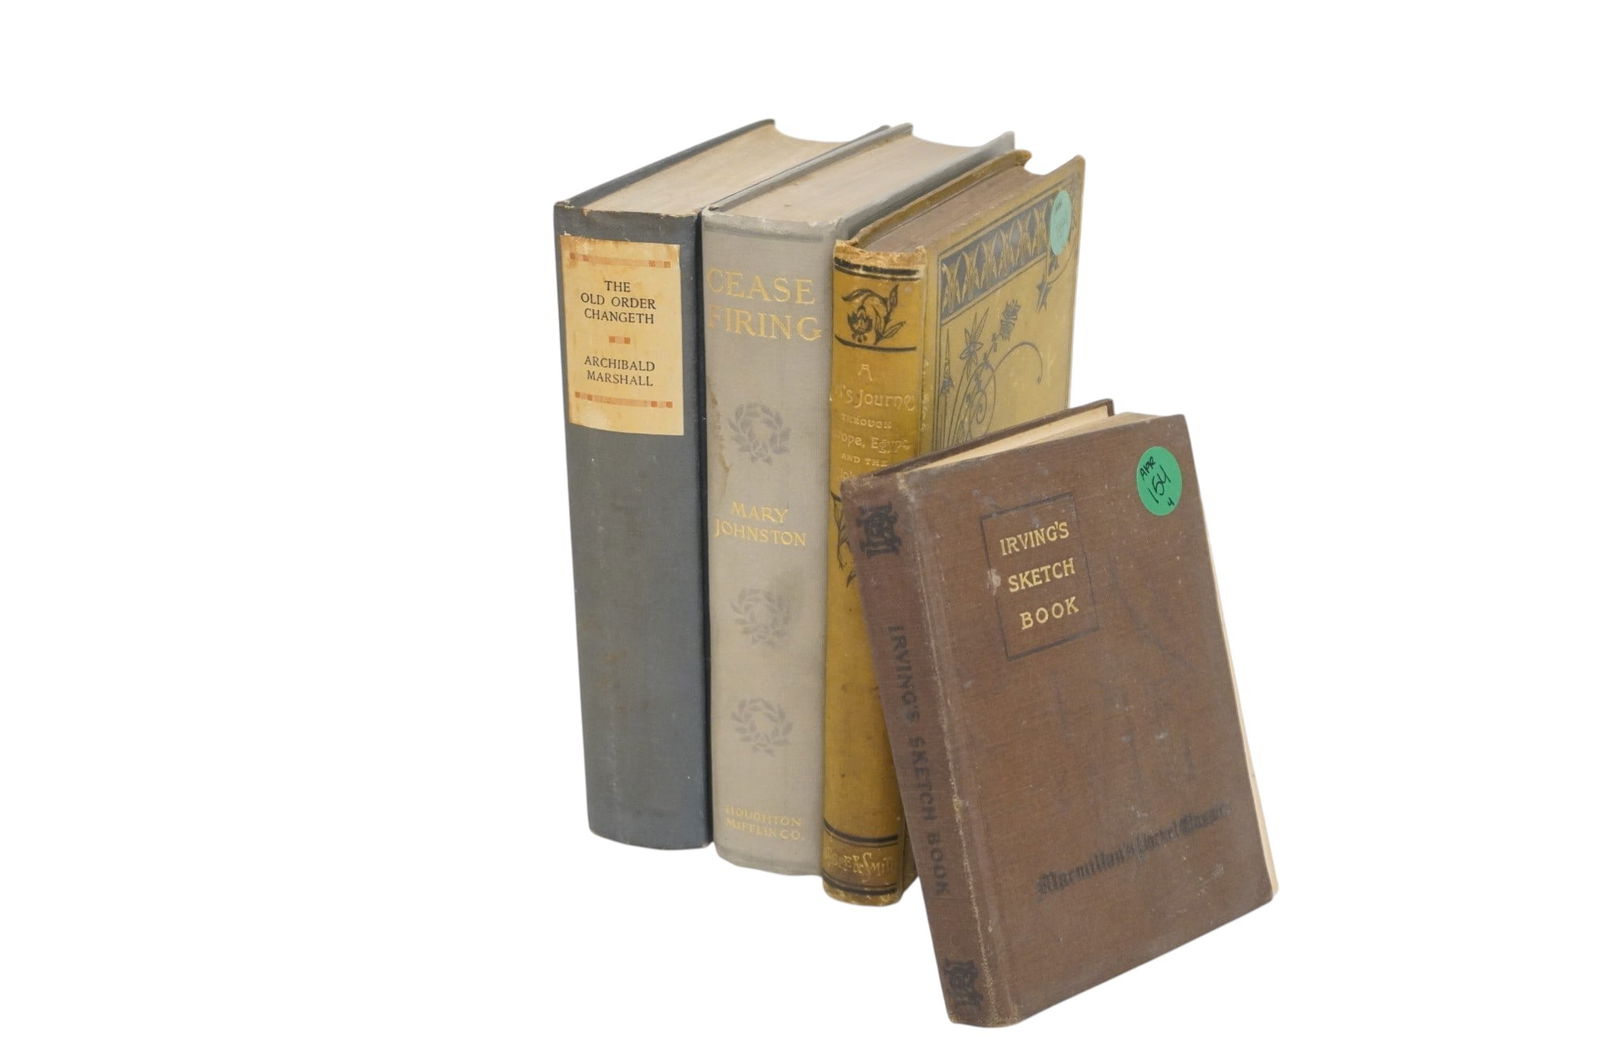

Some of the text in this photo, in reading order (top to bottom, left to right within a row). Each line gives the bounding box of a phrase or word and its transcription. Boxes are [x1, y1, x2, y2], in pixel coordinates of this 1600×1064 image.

[604, 280, 631, 293] THE
[706, 268, 816, 305] CEASE
[580, 292, 656, 310] OLD ORDER
[584, 308, 654, 324] CHANGETH
[707, 304, 822, 341] FIRING
[584, 355, 655, 372] ARCHIBALD
[587, 370, 653, 387] MARSHALL
[731, 501, 790, 524] MARY
[714, 518, 807, 547] JOHNSTON
[999, 521, 1070, 556] IRVING'S
[1008, 557, 1076, 593] SKETCH
[1019, 596, 1080, 630] BOOK
[886, 625, 948, 893] IRVING'S SKETCH BOOK
[725, 805, 802, 826] HOUGHTON
[726, 817, 778, 839] MIFFLIN
